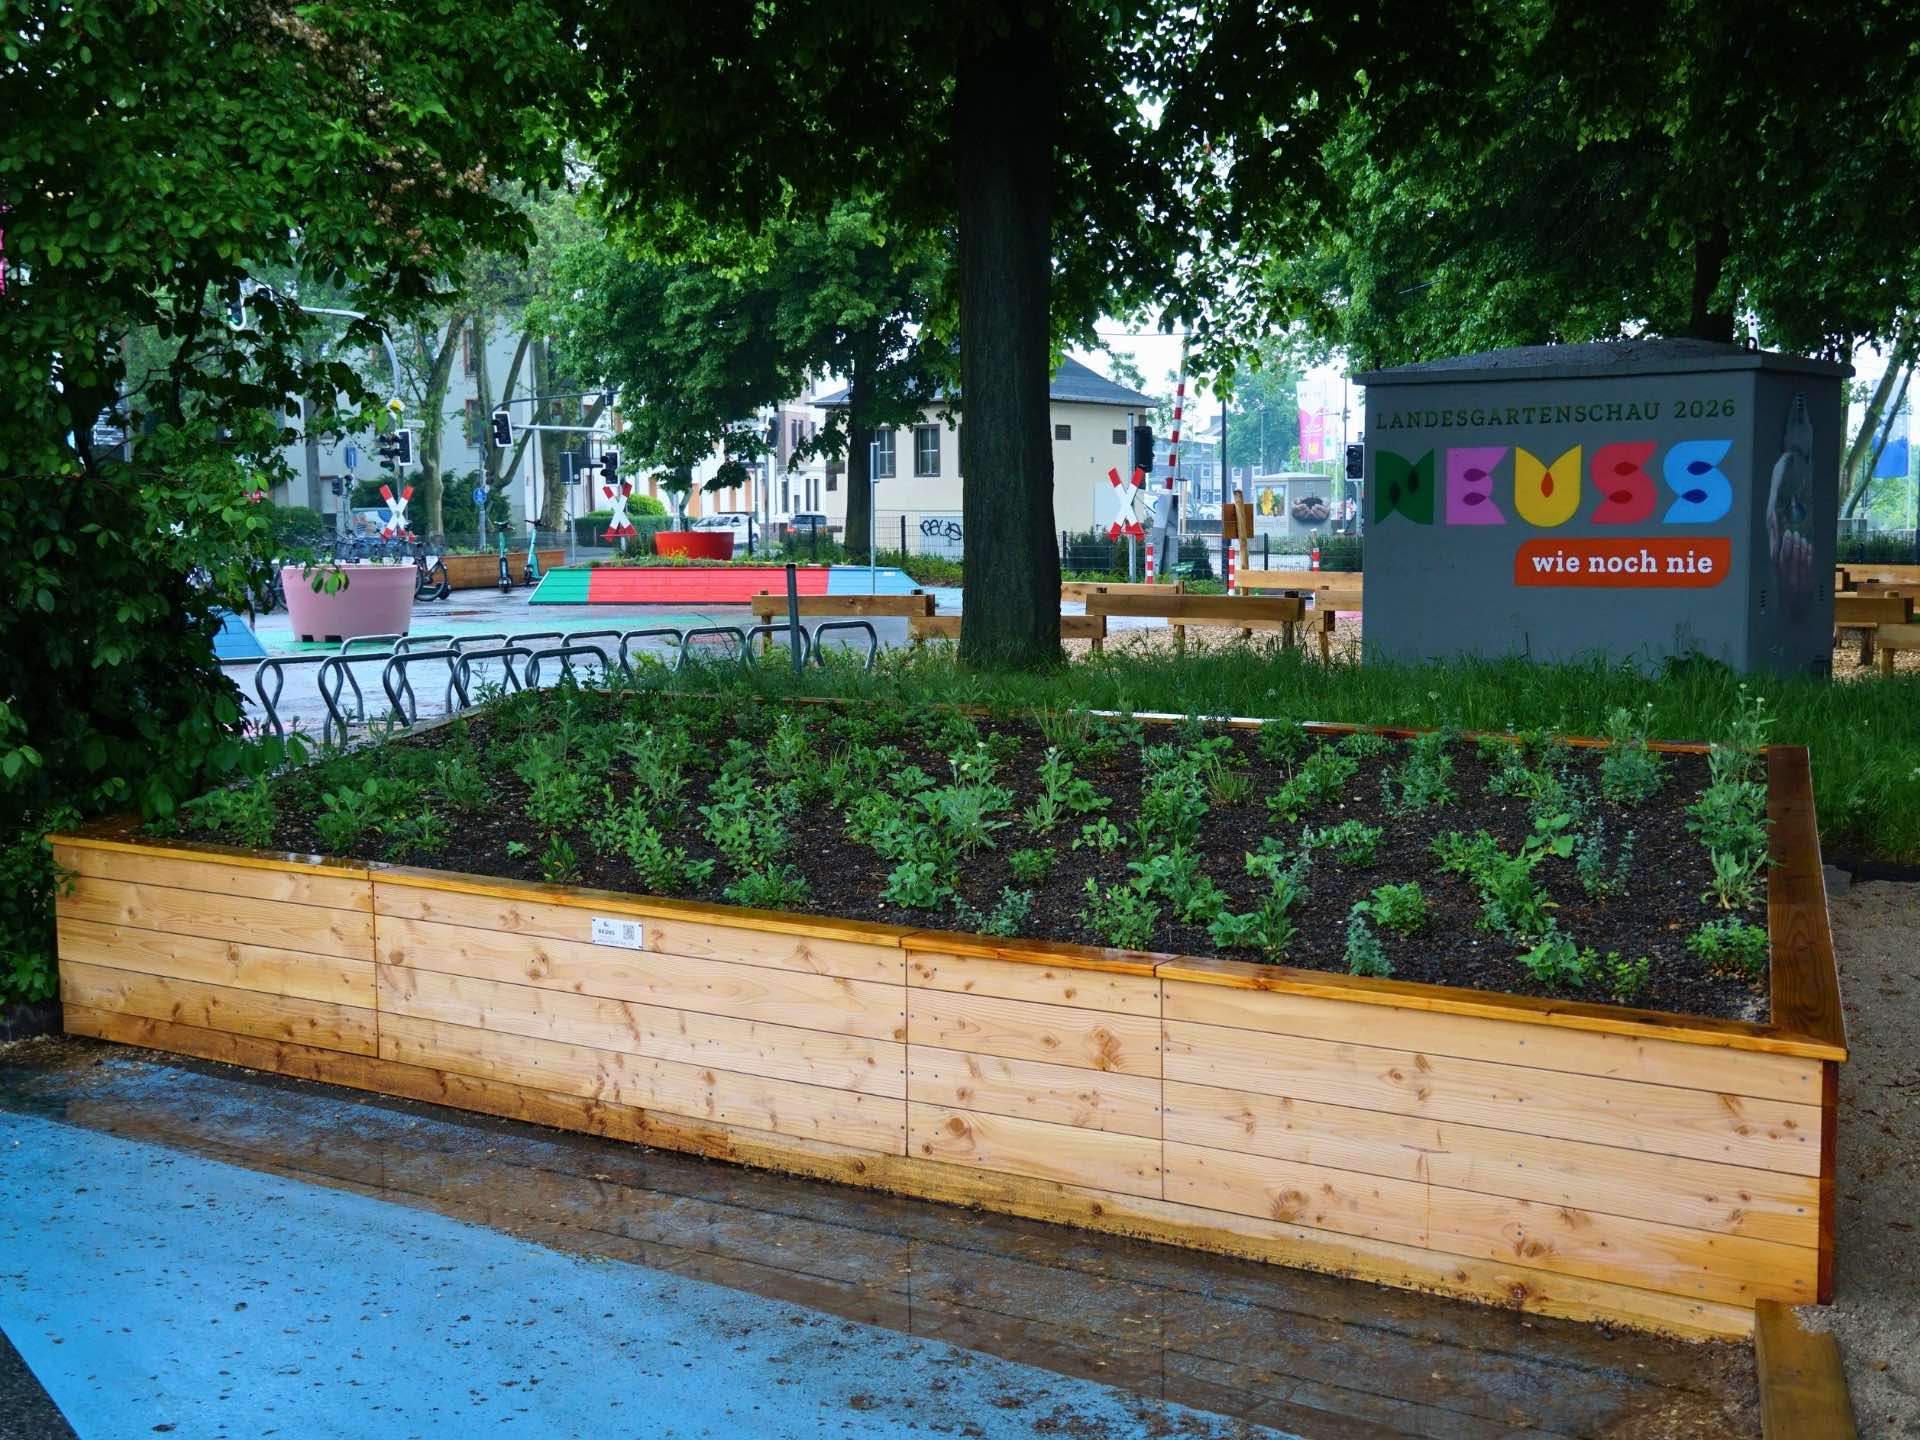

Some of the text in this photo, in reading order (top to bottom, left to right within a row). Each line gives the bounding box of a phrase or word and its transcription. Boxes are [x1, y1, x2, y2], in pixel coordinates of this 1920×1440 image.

[1376, 399, 1735, 430] LANDESGARTENSCHAU 2026
[1374, 439, 1734, 527] NEUSS
[1532, 549, 1713, 573] wie noch nie
